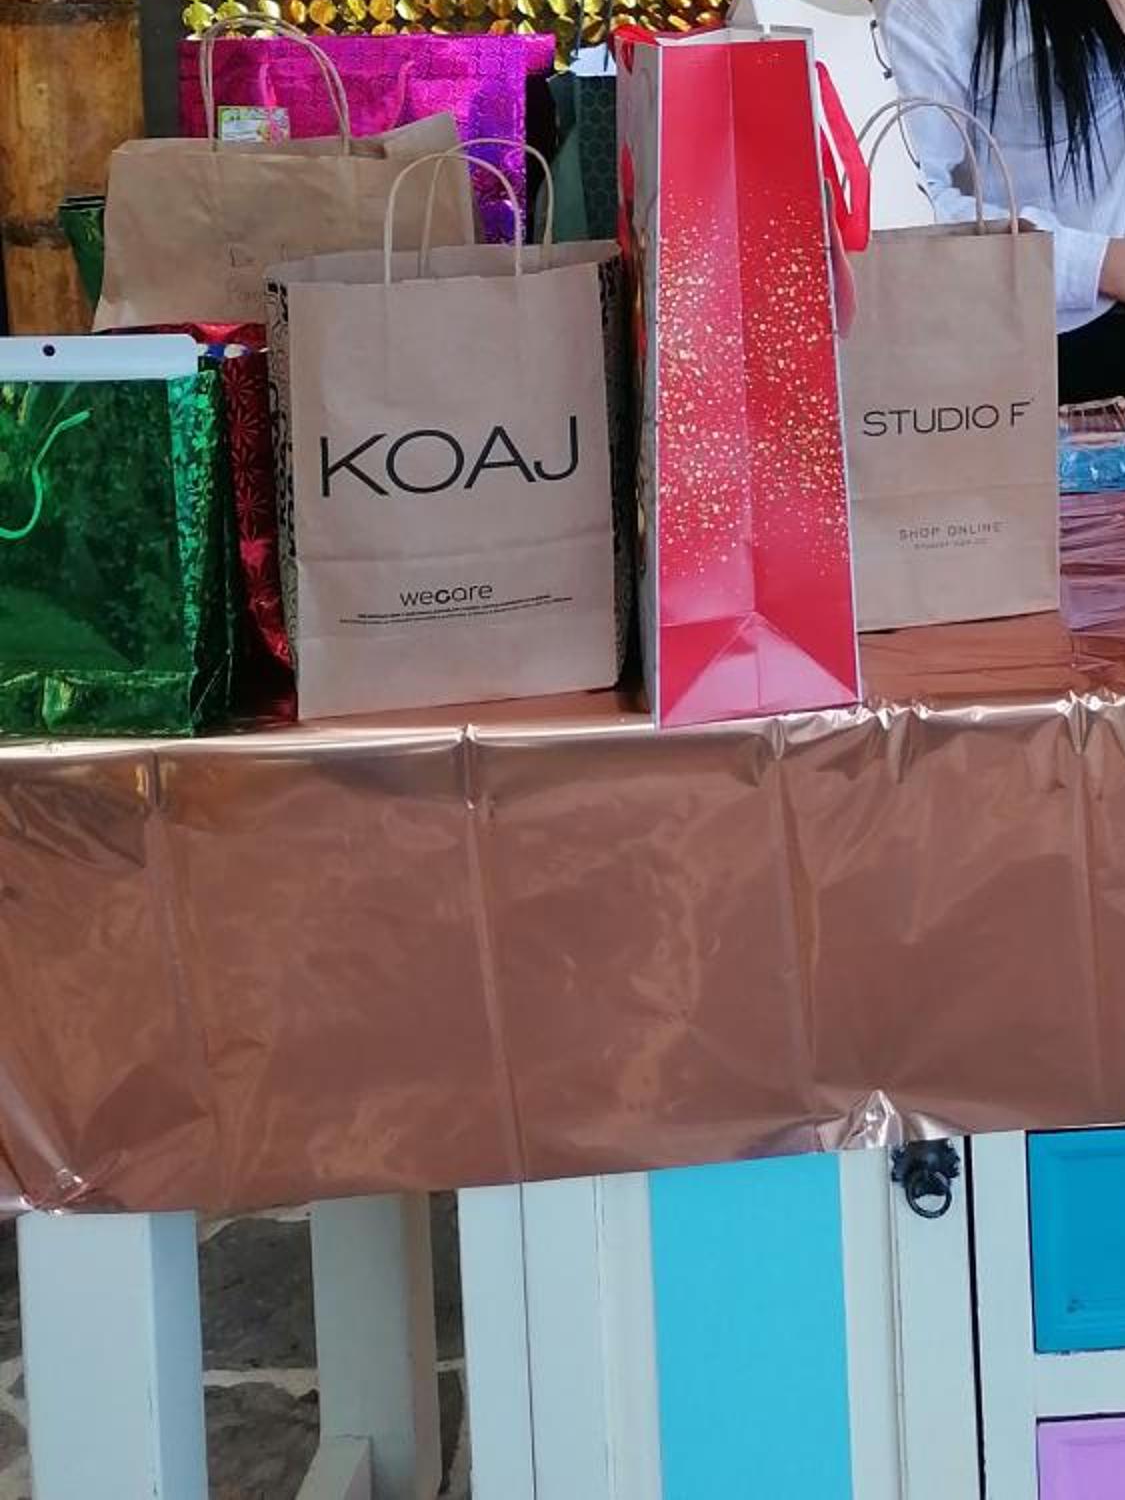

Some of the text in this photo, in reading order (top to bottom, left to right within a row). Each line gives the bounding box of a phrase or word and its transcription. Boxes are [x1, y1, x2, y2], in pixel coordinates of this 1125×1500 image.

[863, 400, 1033, 437] STUDIO F
[319, 415, 580, 498] KOAJ
